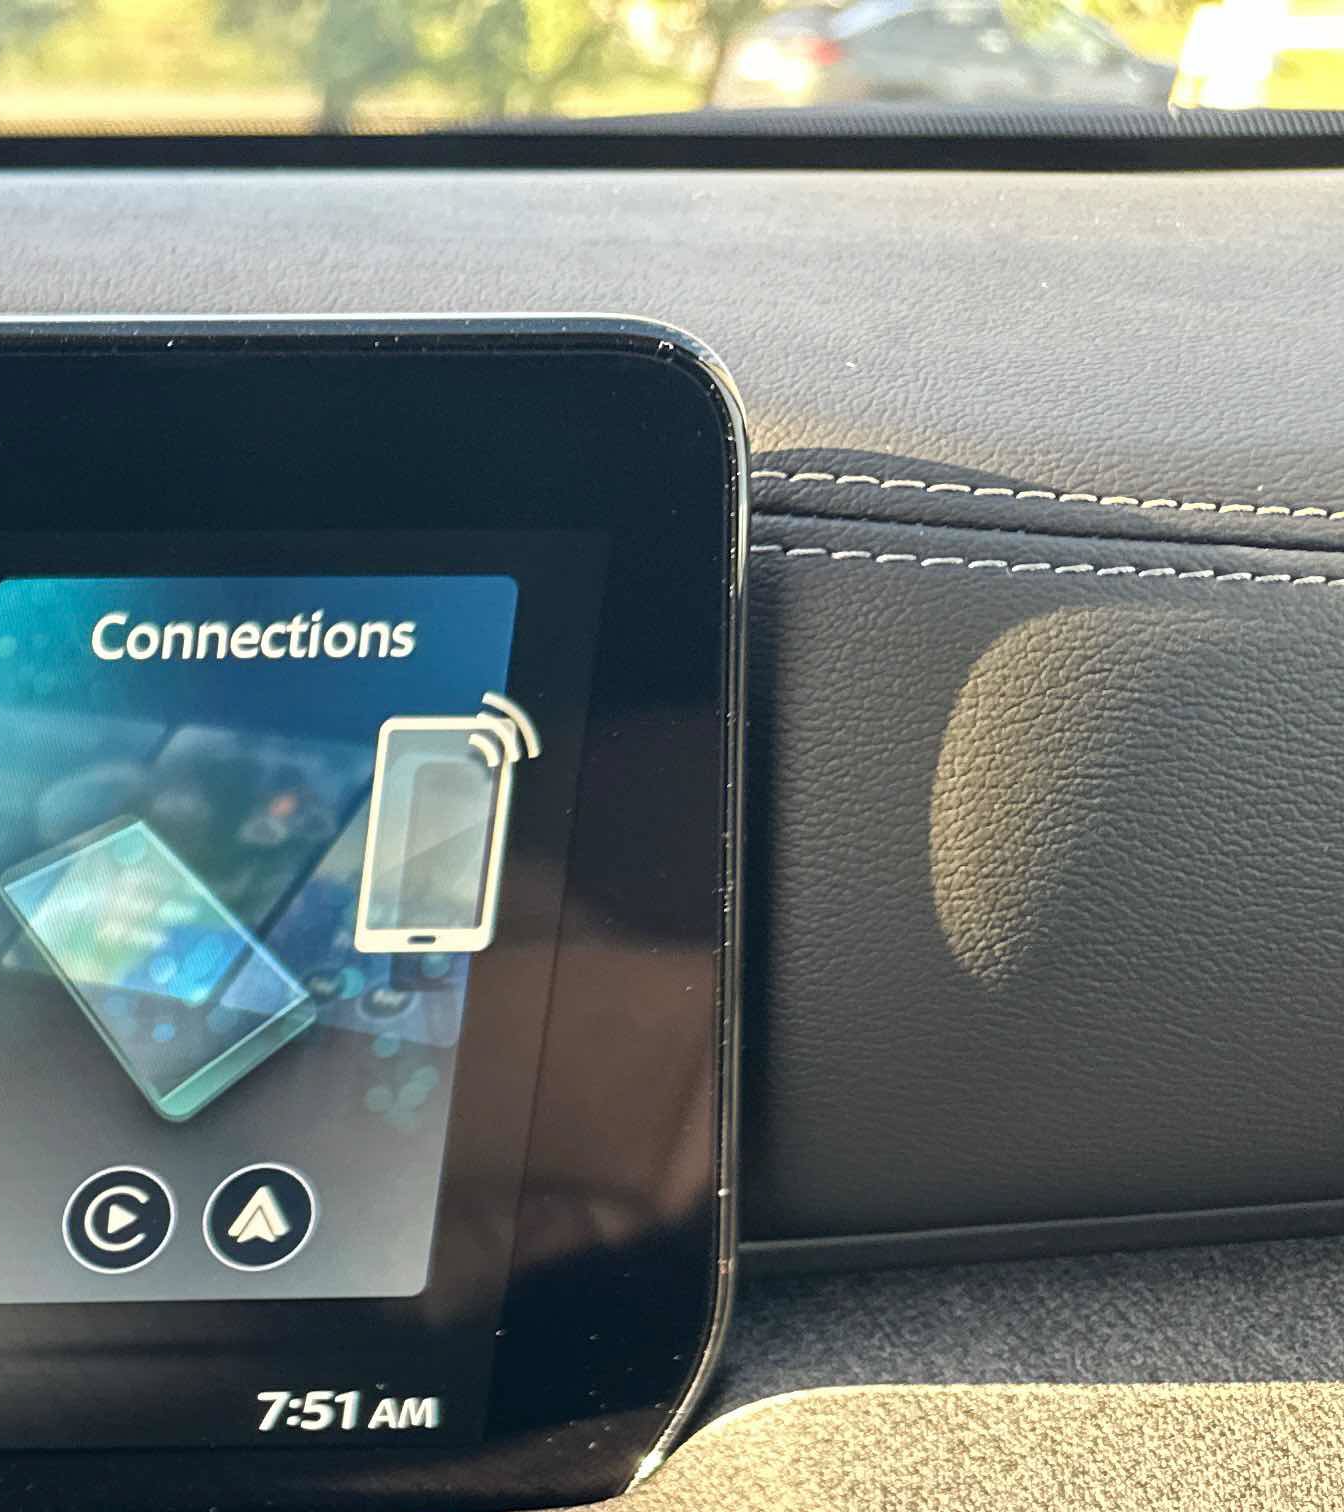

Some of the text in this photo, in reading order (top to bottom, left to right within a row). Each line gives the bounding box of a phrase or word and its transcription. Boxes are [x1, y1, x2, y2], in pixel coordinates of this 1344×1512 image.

[91, 608, 418, 661] Connections
[257, 1389, 439, 1432] 7:51 AM
